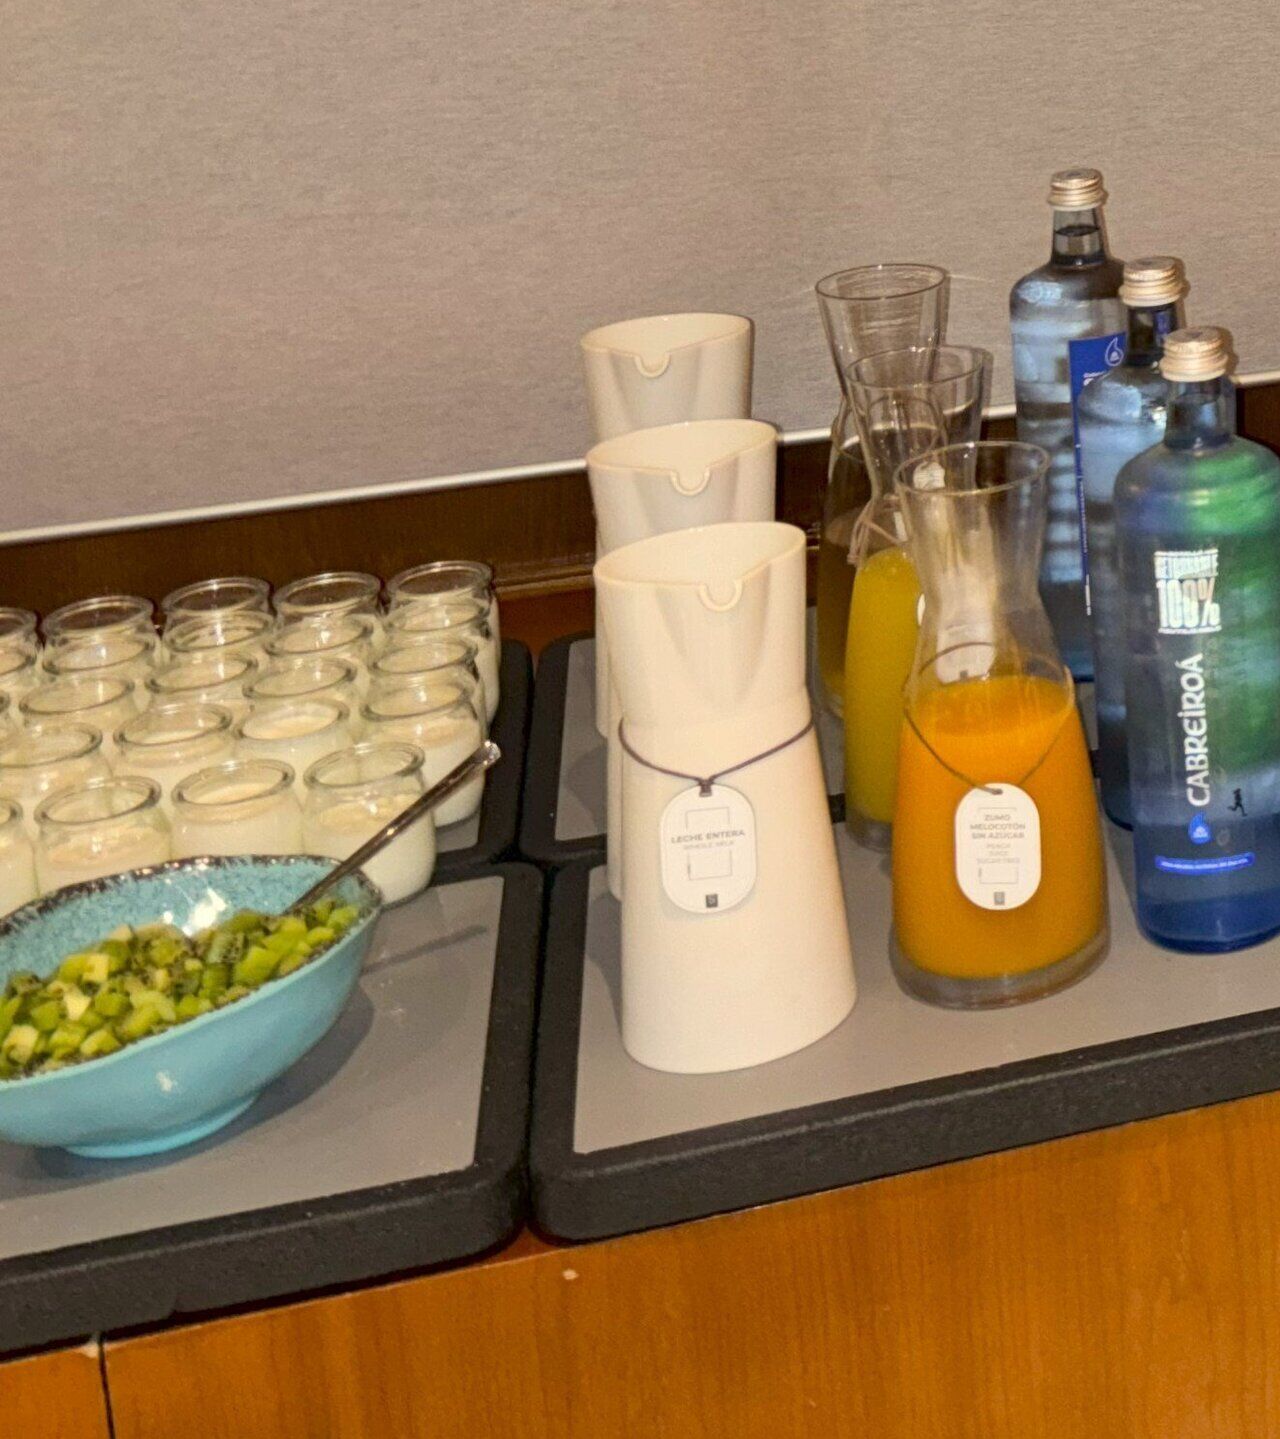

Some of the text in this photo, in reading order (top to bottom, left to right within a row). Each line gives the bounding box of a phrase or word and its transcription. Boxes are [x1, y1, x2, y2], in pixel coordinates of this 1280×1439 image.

[1156, 577, 1220, 628] 100%
[671, 829, 746, 844] LECHE ENTERA
